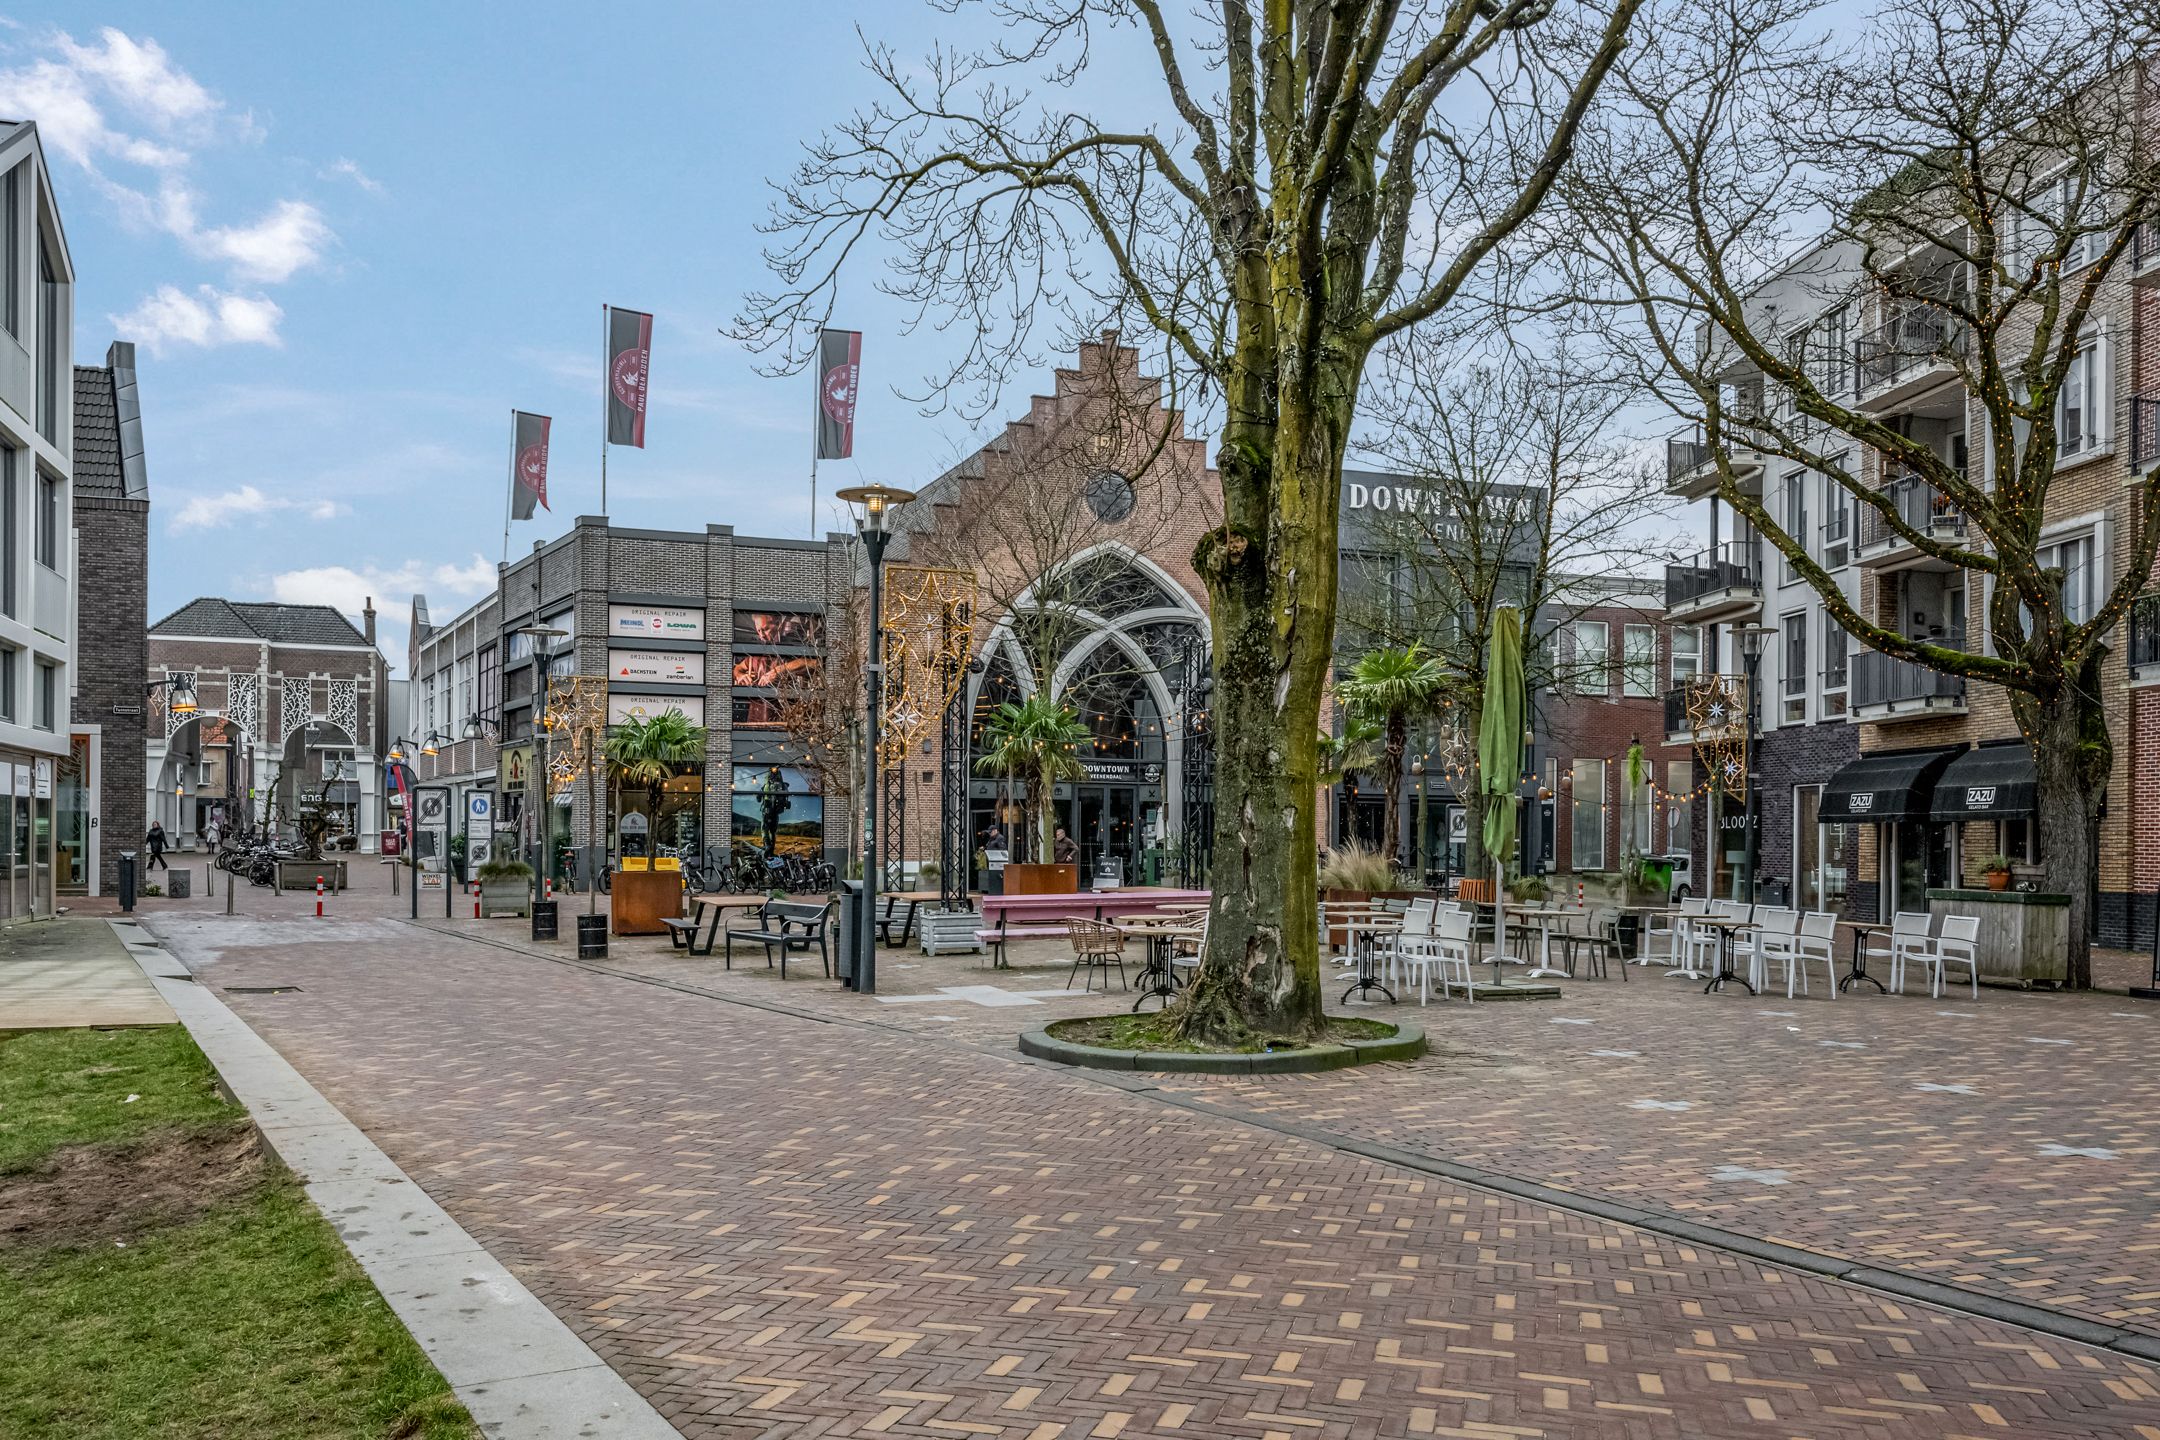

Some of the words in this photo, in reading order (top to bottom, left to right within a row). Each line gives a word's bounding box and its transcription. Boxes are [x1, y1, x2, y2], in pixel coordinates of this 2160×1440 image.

[637, 394, 645, 412] PAUL
[641, 350, 649, 375] OUDEN
[848, 390, 856, 404] DEN
[1349, 483, 1532, 522] DOWNTOWN
[1082, 764, 1130, 774] DOWNTOWN
[1851, 795, 1872, 807] ZAZU
[1968, 790, 1994, 802] ZAZU
[1720, 815, 1758, 829] BLOOZ
